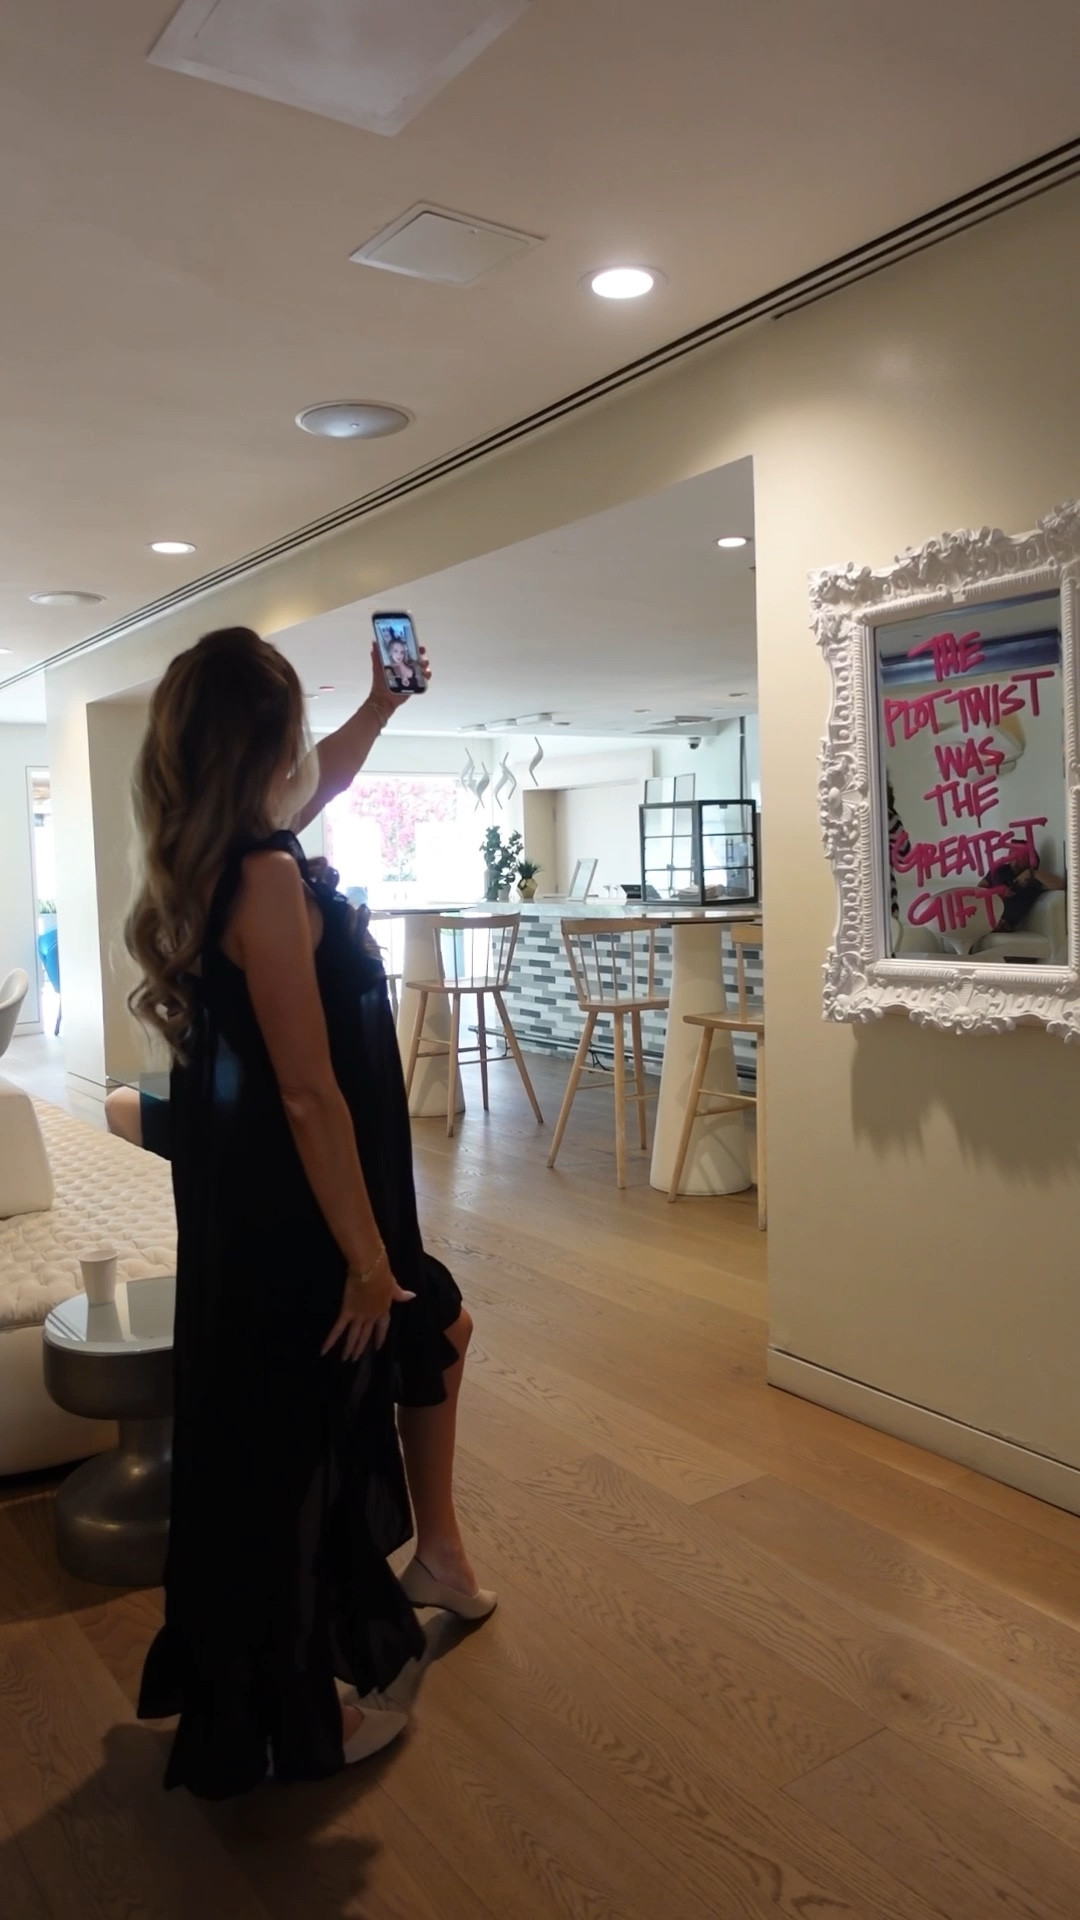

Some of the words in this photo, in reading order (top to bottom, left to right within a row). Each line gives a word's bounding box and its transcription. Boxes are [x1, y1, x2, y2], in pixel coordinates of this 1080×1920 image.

[907, 631, 985, 683] THE
[884, 688, 952, 747] PLOT
[944, 670, 1055, 728] TWIST
[935, 736, 1005, 781] WAS
[924, 775, 999, 827] THE
[892, 817, 1048, 887] GREATEST
[908, 885, 1006, 932] GIFT
